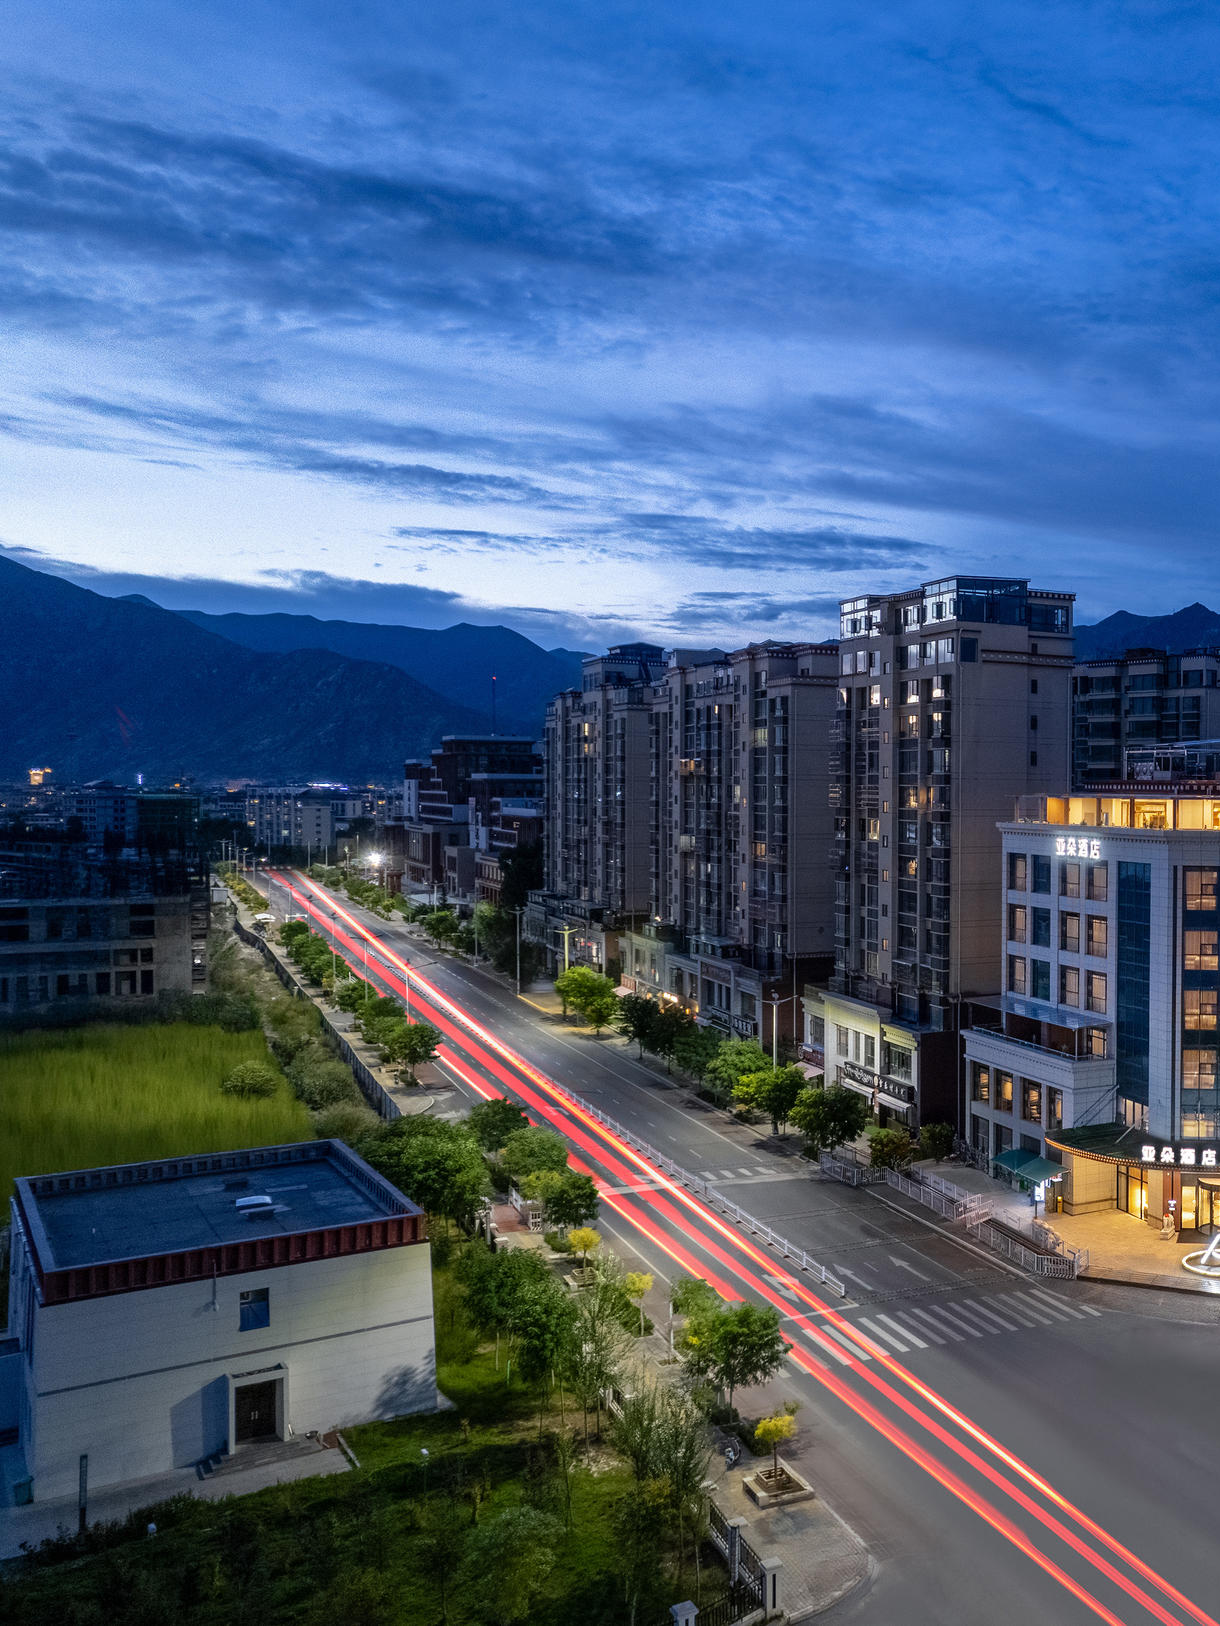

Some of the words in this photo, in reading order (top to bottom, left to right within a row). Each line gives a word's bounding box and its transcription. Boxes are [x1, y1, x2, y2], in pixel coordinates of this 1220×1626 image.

[1055, 837, 1101, 860] 亚朵酒店
[1141, 1145, 1217, 1165] 亚朵酒店
